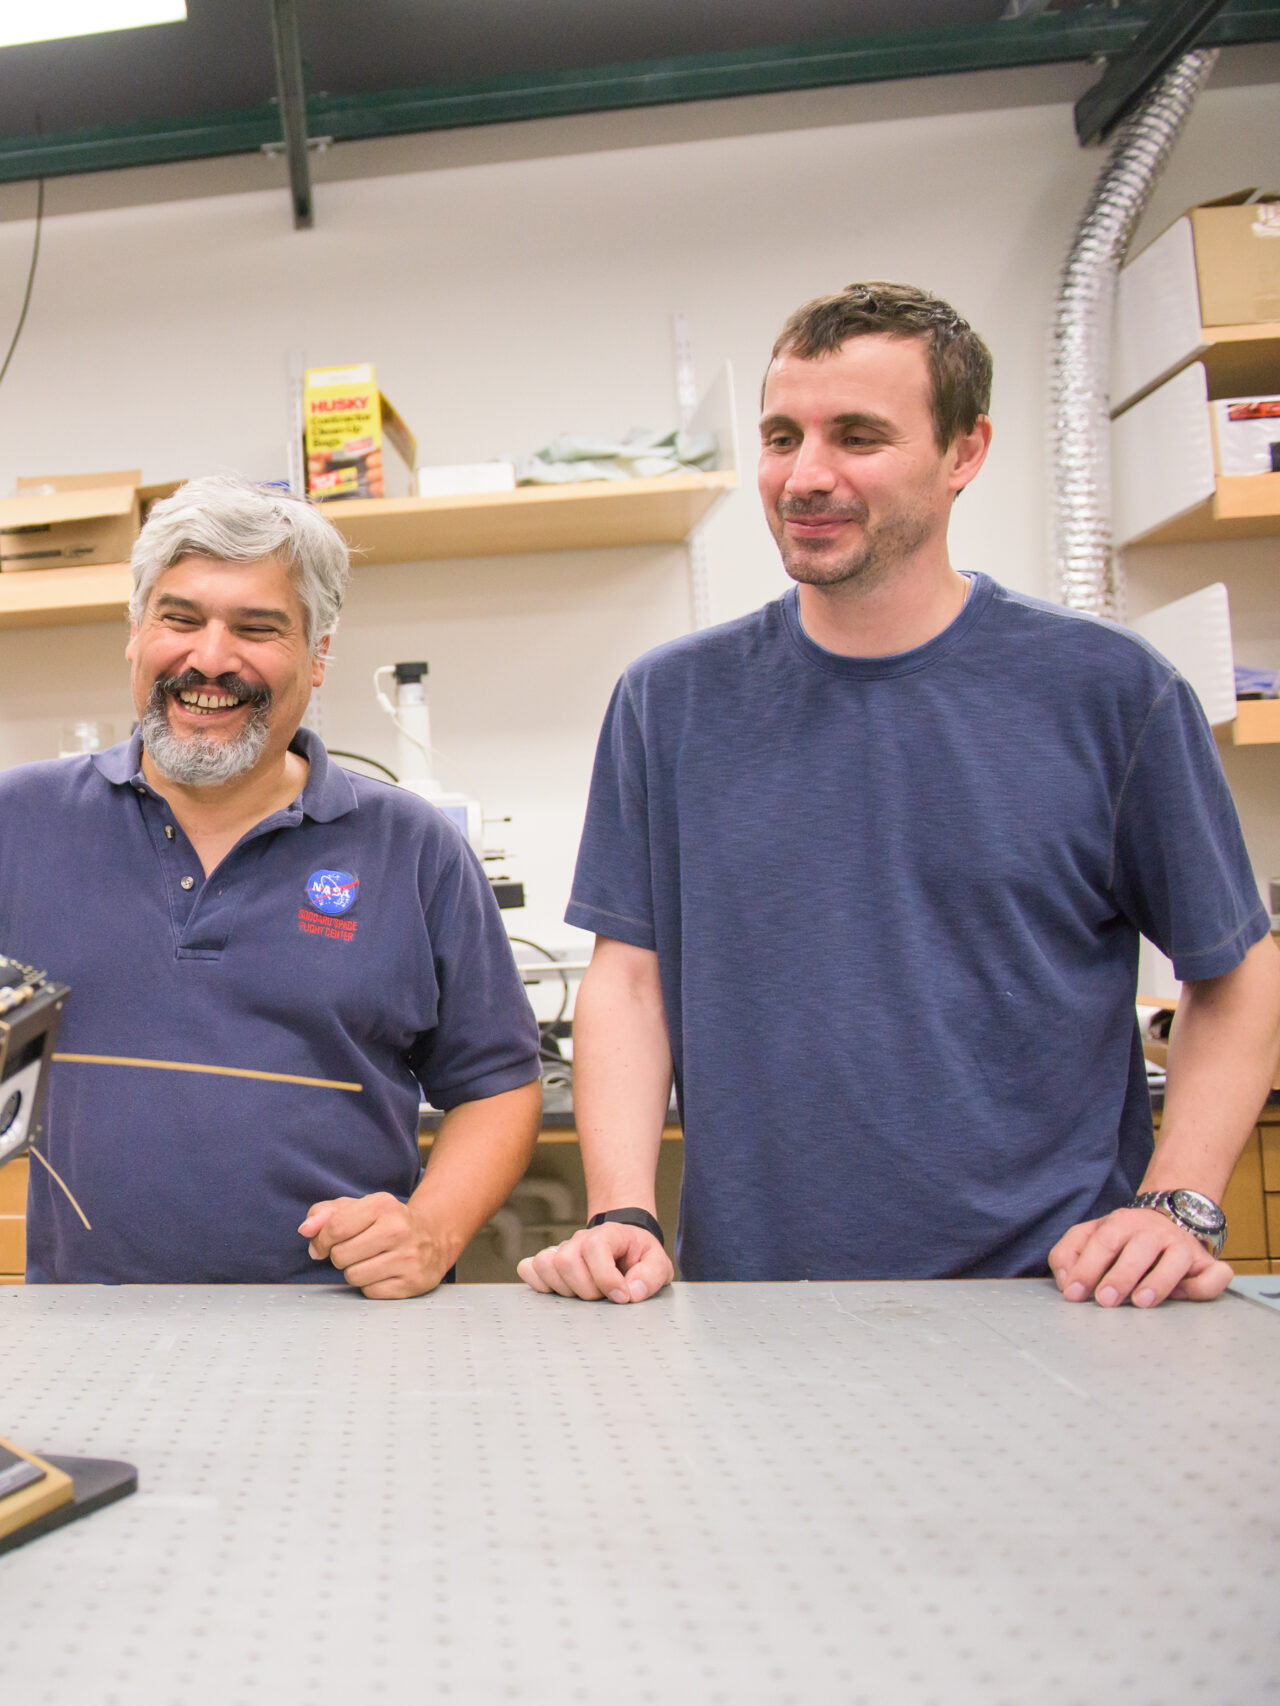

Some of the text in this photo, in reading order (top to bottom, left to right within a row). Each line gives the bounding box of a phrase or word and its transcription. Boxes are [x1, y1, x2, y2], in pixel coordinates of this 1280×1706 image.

[311, 397, 369, 413] HUSKY
[312, 881, 351, 900] NASA
[298, 908, 358, 931] GODDARD SPACE
[299, 921, 354, 941] FLIGHT CENTER
